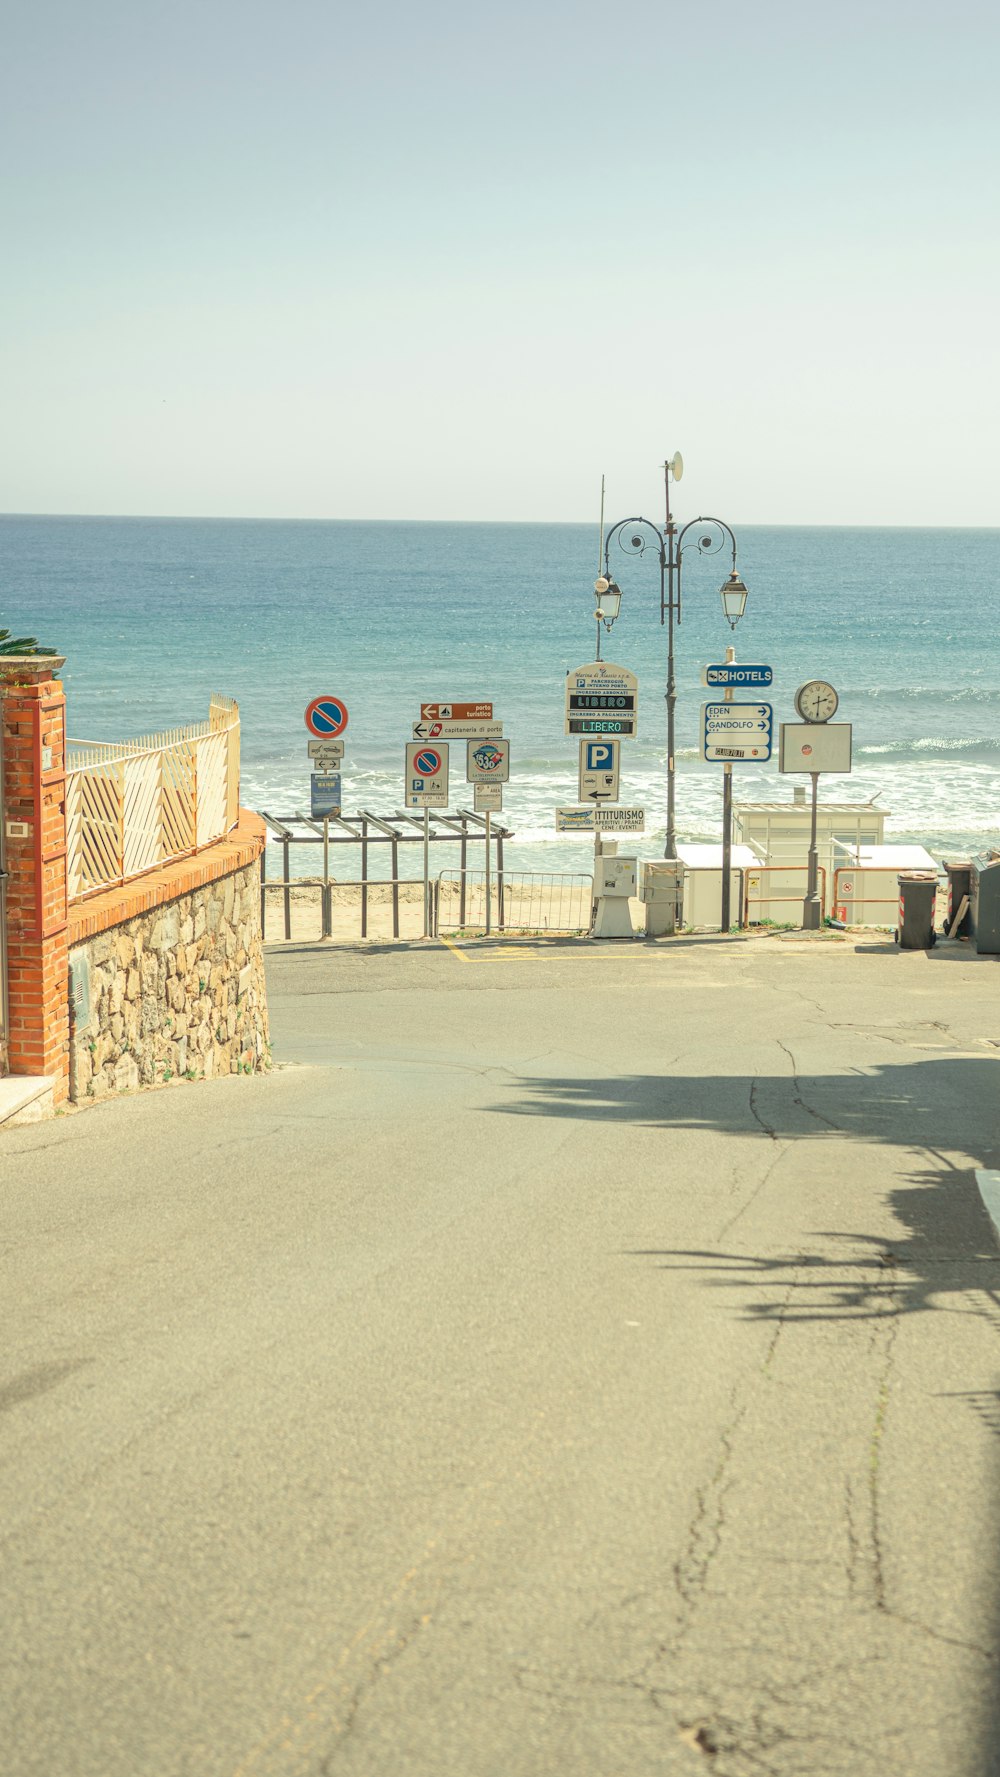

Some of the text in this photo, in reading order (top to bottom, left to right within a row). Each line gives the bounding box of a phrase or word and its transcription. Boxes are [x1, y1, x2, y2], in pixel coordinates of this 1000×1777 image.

[729, 671, 772, 680] HOTELS
[577, 696, 626, 707] LIBERO
[582, 721, 620, 731] LIBERO
[474, 753, 494, 769] 1530
[591, 745, 608, 767] P
[414, 780, 422, 789] P
[595, 810, 644, 819] ITTITURISMO
